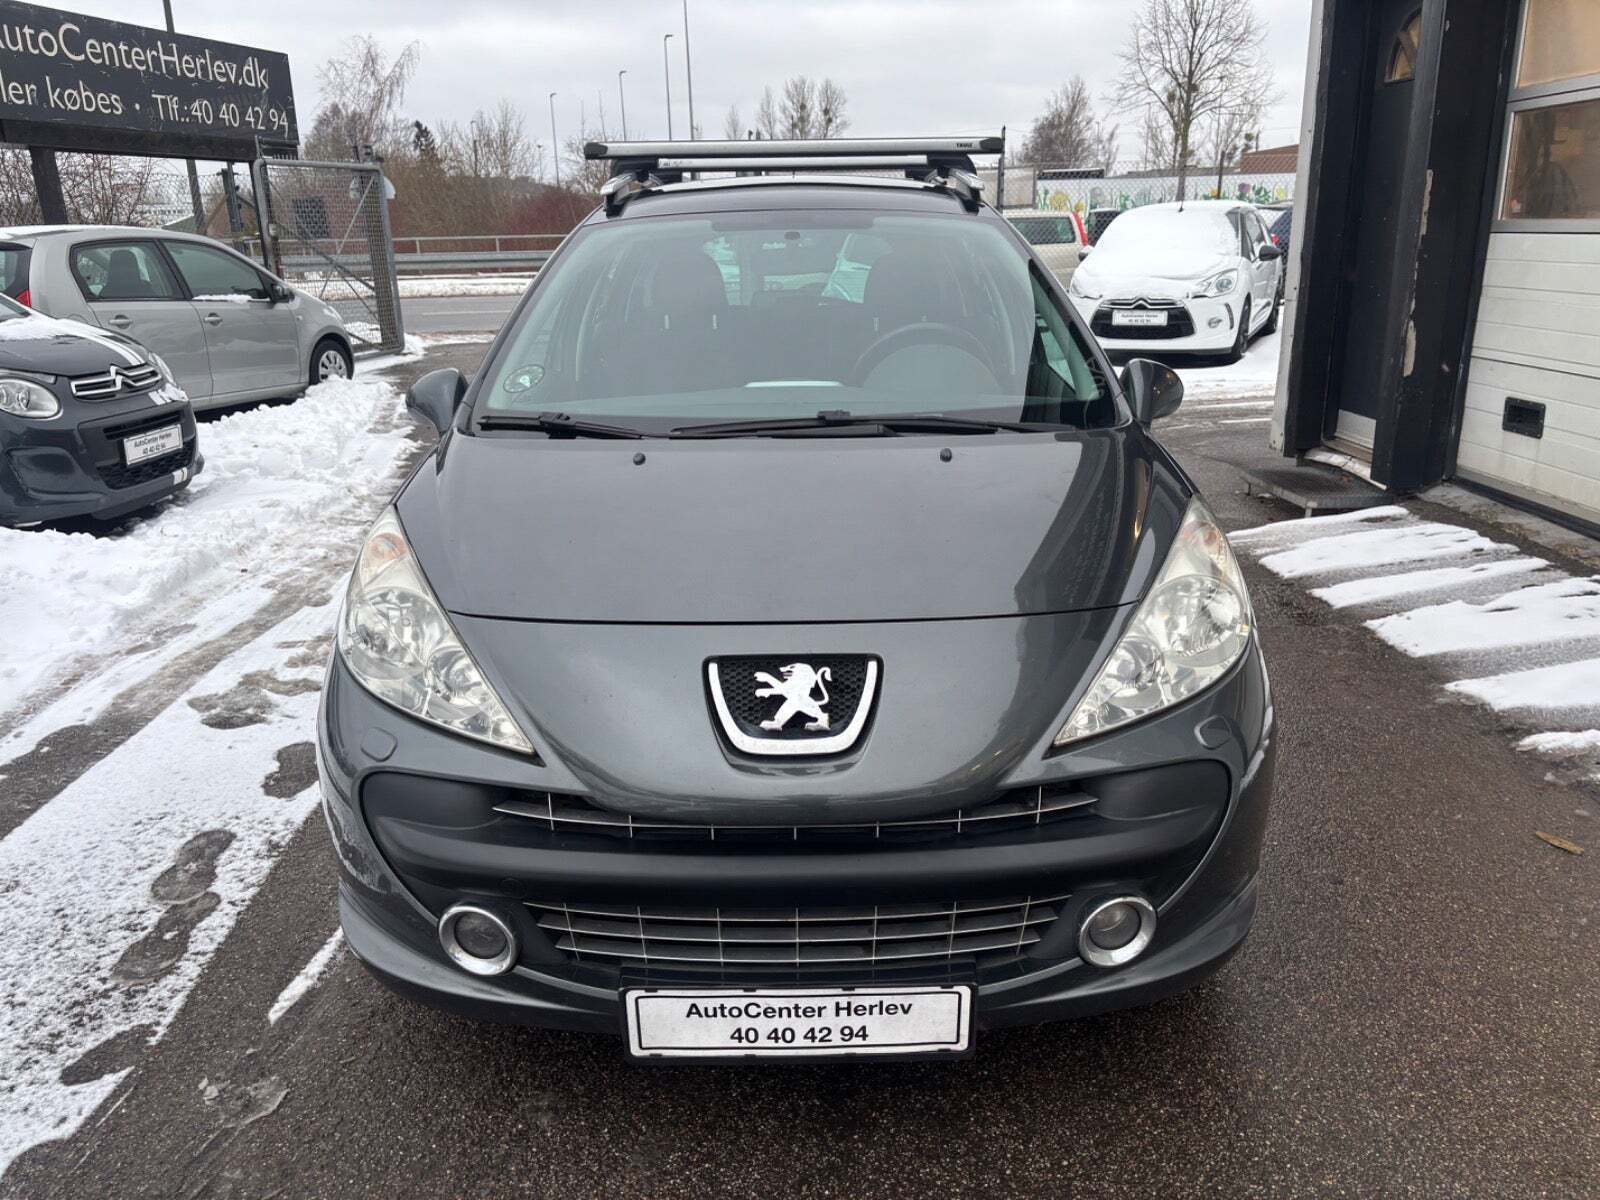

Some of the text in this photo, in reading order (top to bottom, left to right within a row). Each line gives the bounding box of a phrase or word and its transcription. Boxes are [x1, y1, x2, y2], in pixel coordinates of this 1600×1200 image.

[0, 23, 269, 89] utoCenterHerlev.dk
[45, 75, 124, 114] købes
[219, 102, 240, 127] 40
[244, 105, 266, 130] 42
[269, 108, 289, 138] 94
[686, 1000, 913, 1019] AutoCenter Herlev
[730, 1025, 869, 1044] 40 40 42 94
